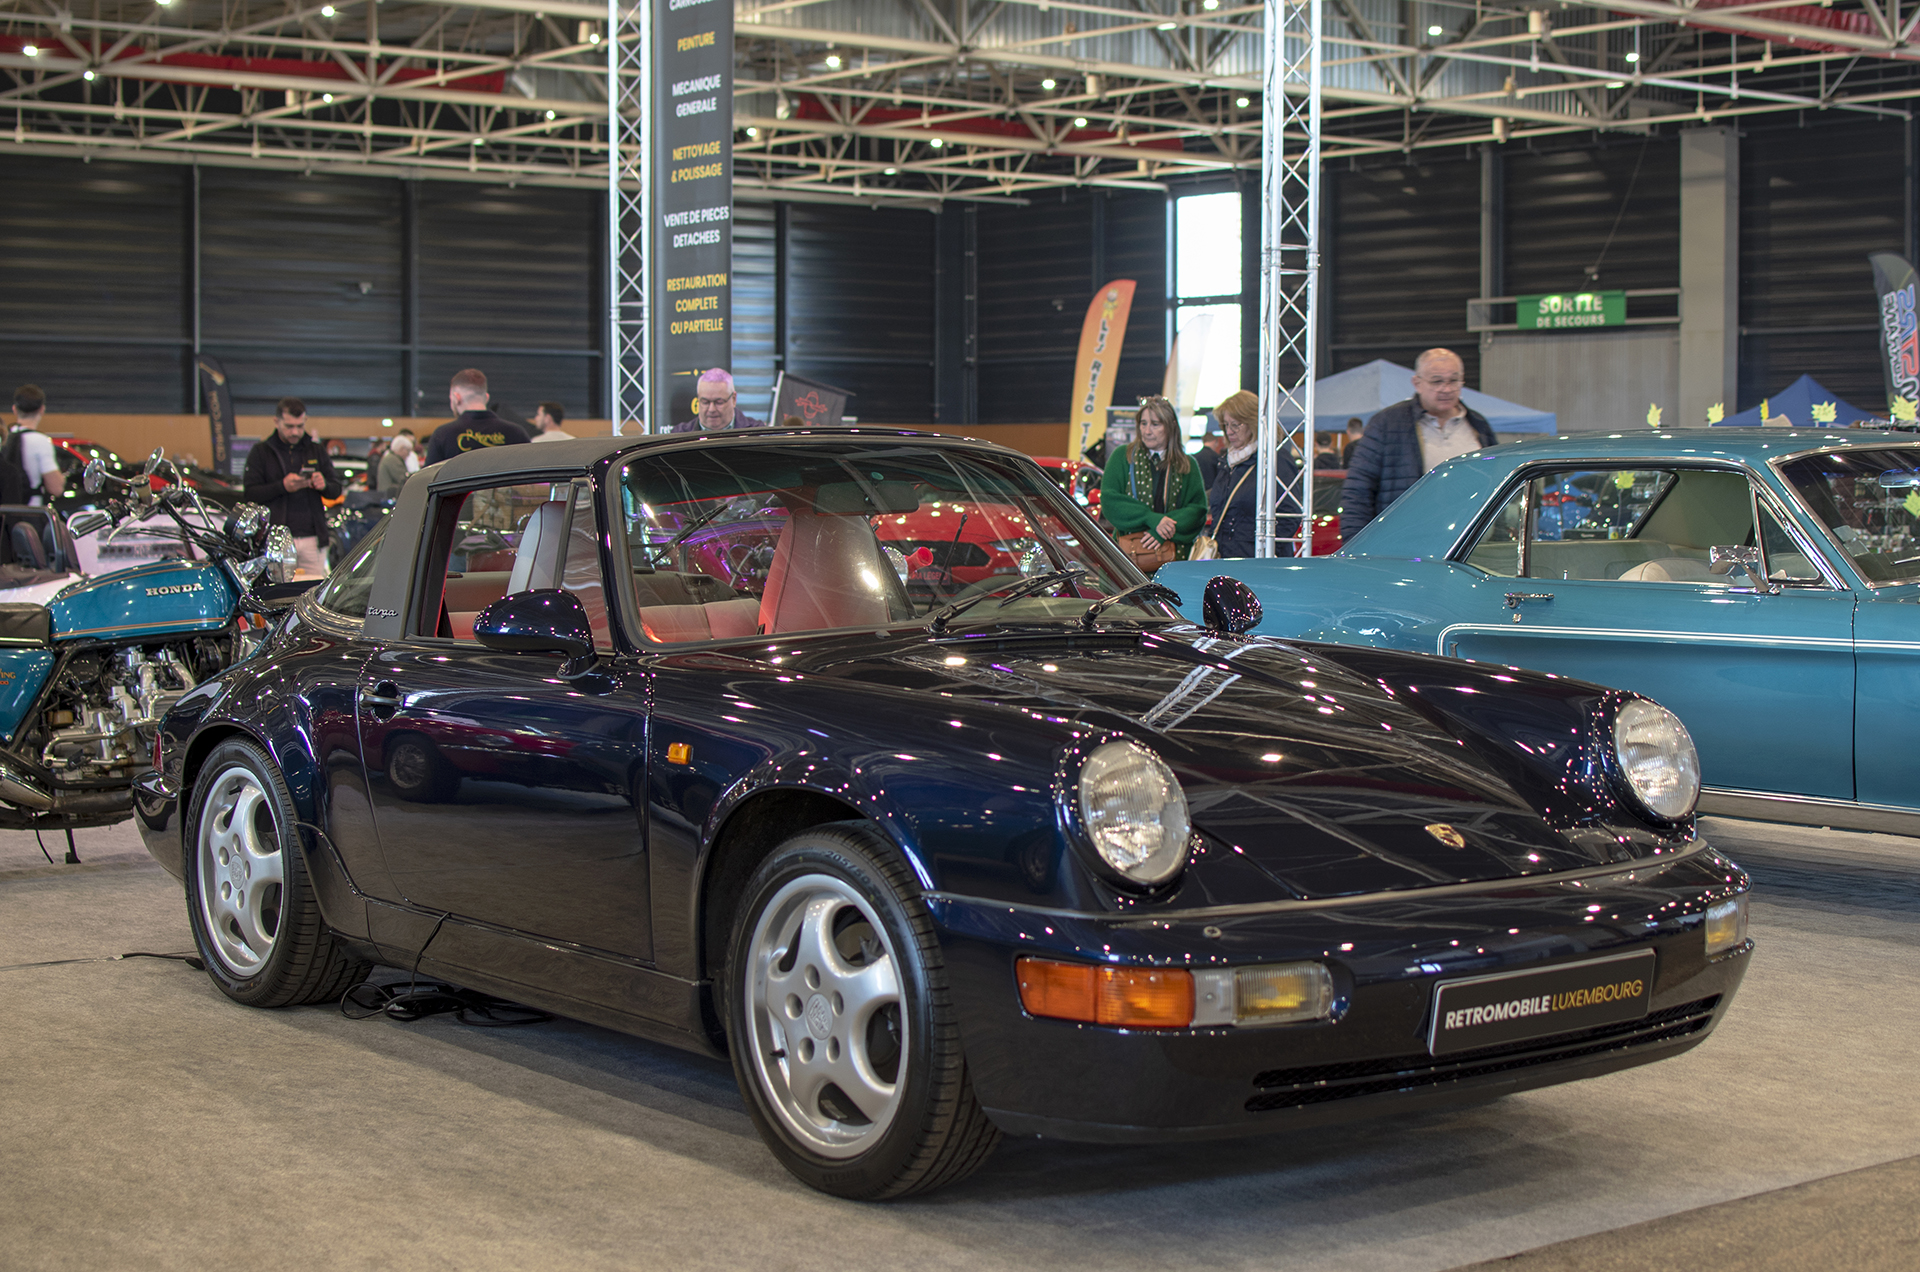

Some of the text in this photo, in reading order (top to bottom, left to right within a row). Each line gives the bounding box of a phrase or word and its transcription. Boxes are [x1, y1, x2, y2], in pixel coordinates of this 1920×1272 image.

[677, 31, 715, 52] PEINTURE
[672, 74, 721, 97] MECANIQUE
[676, 97, 717, 117] GENERALE
[672, 141, 721, 161] NETTOYAGE
[671, 162, 723, 183] & POLISSAGE
[663, 206, 729, 227] VENTE DE PIECES
[673, 229, 720, 248] DETACHEES
[666, 273, 727, 292] RESTAURATION
[675, 296, 718, 313] COMPLETE
[1540, 296, 1603, 313] SORTIE
[670, 317, 723, 335] OU PARTIELLE
[1537, 314, 1605, 328] DE SECOURS
[145, 582, 204, 597] HONDA
[368, 605, 399, 619] targa
[1444, 978, 1643, 1030] RETROMOBILE LUXEMBOURG
